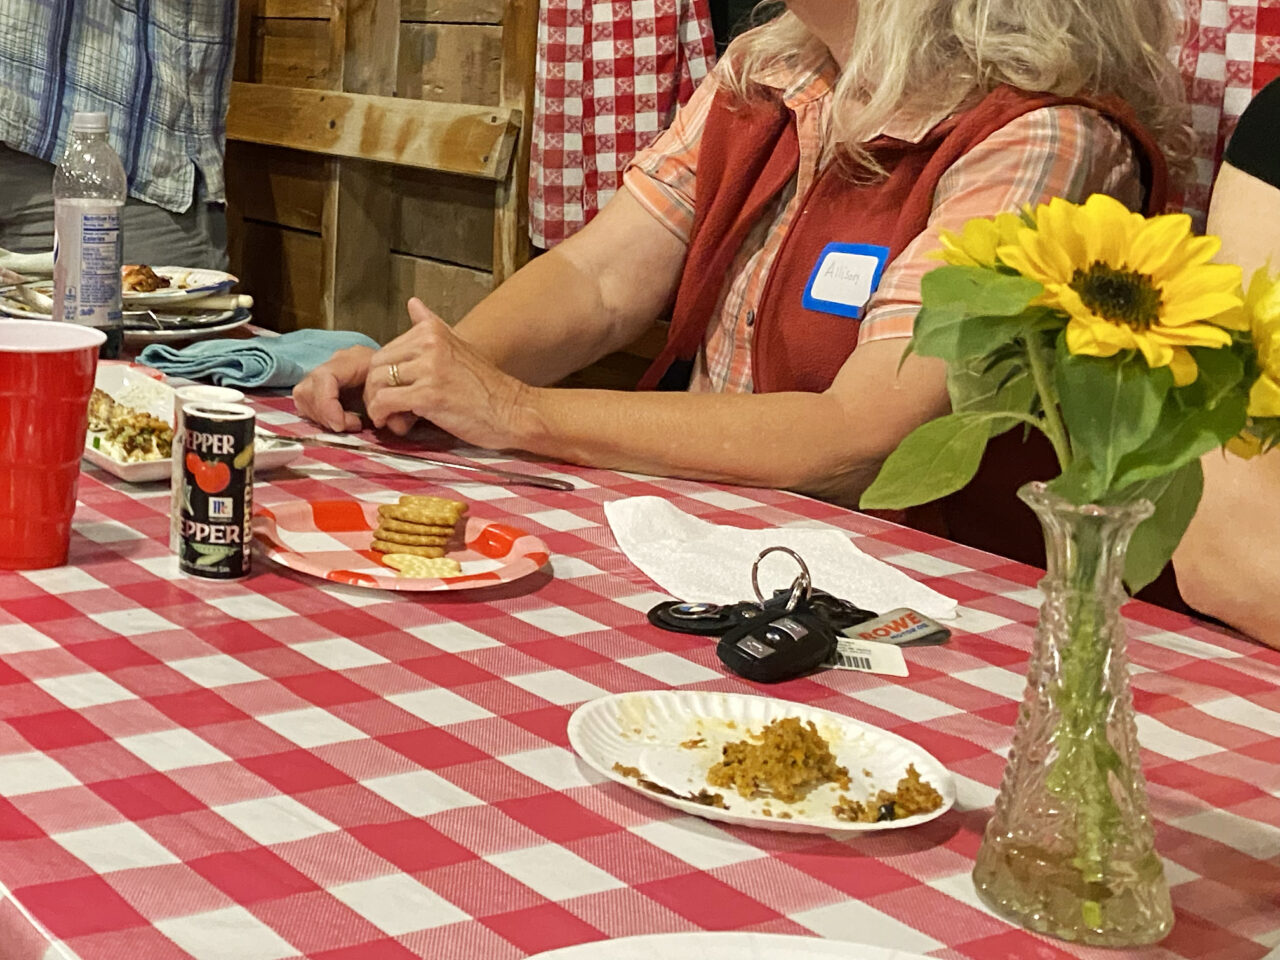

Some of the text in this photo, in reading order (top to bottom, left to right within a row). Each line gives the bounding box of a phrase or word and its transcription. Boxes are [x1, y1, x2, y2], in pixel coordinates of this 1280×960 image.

[825, 261, 860, 285] Allison
[186, 429, 235, 454] EPPER
[180, 516, 240, 543] EPPER
[858, 611, 922, 640] ROWE
